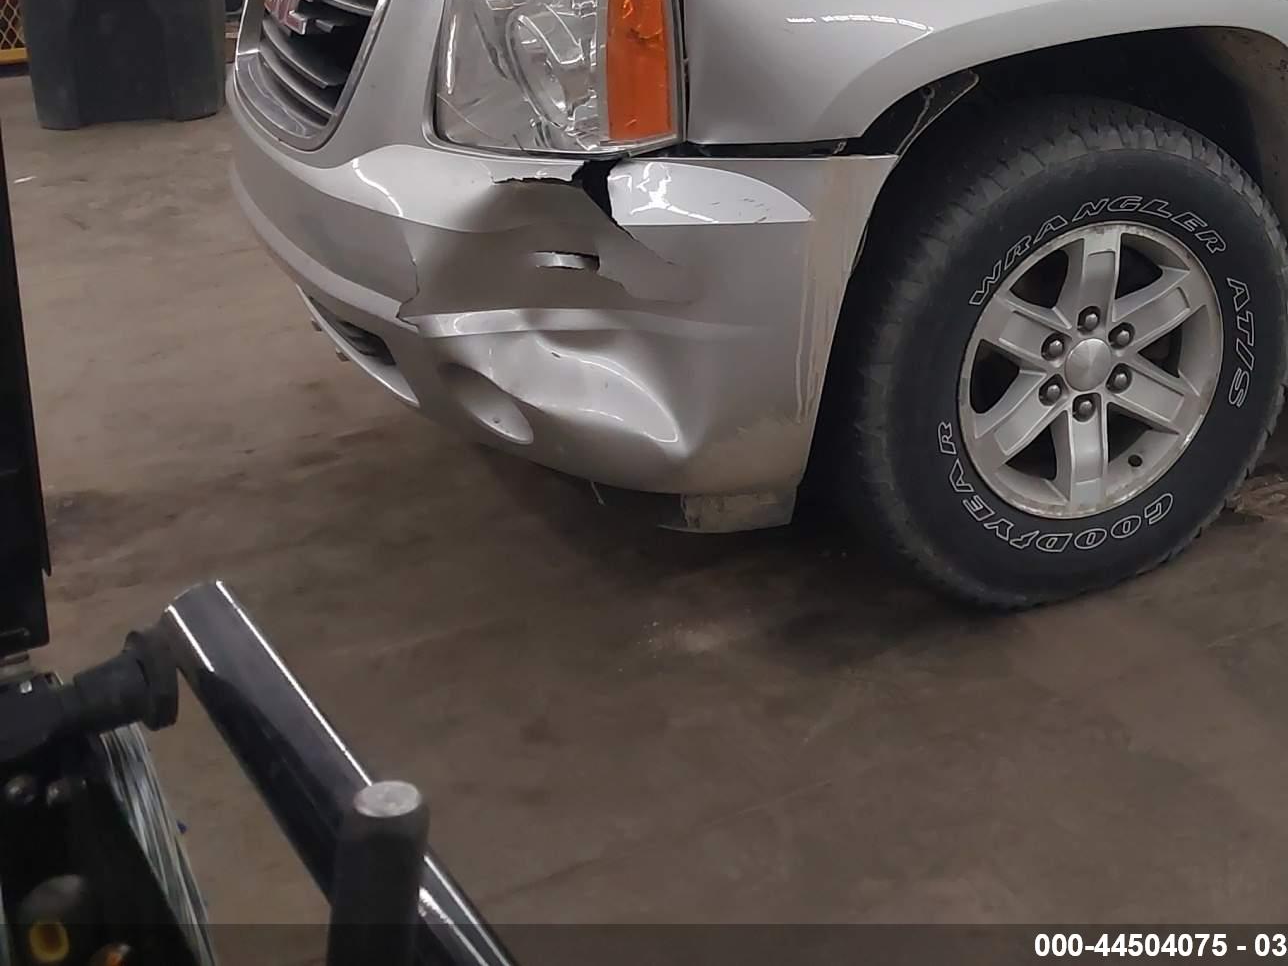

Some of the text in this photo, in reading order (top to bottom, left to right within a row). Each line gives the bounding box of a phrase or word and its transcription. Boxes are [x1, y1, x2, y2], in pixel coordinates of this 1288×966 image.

[969, 195, 1256, 408] WRANGLER AT/S
[937, 421, 1175, 553] GOODYEAR
